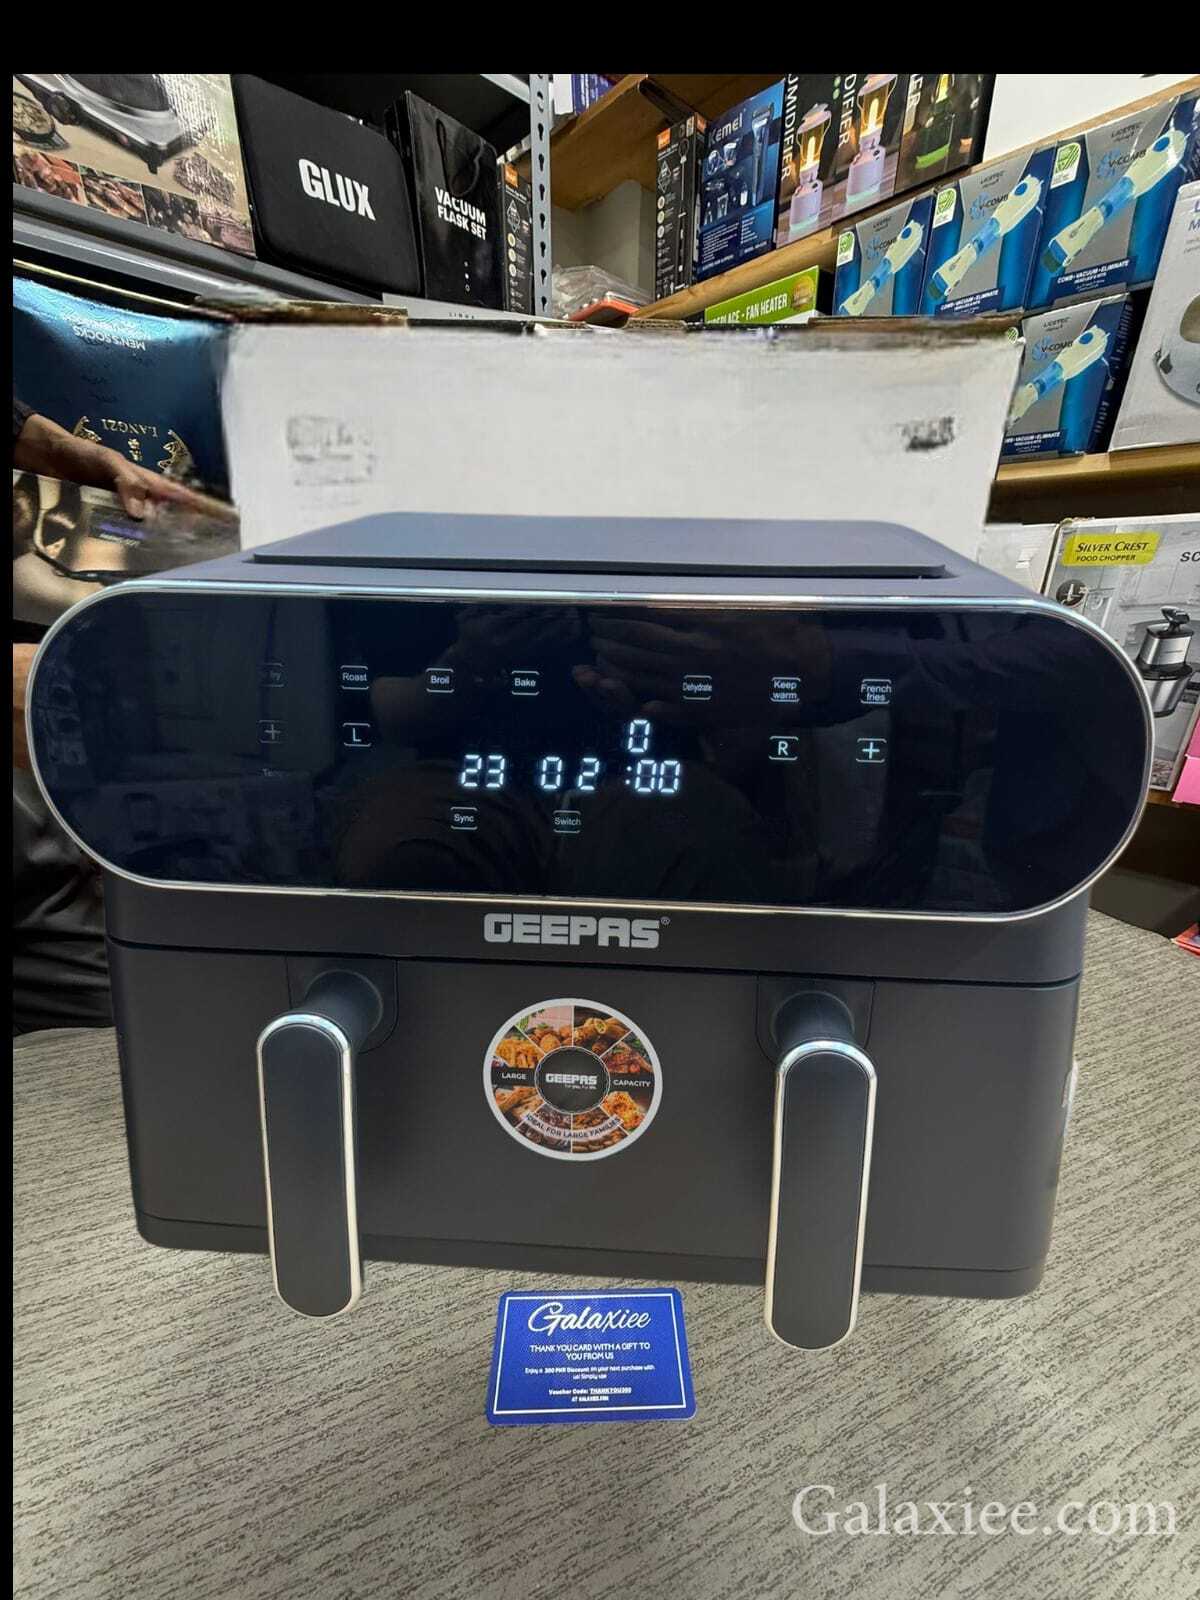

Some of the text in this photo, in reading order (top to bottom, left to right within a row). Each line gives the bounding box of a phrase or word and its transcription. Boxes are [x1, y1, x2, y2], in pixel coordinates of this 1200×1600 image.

[299, 158, 376, 221] GLUX
[435, 186, 486, 227] VACUUM
[438, 205, 486, 240] FLASK SET
[746, 303, 760, 320] FAN
[760, 293, 788, 317] HEATER
[73, 325, 112, 345] SOCKS
[100, 418, 159, 438] LANGZI
[1076, 541, 1149, 553] SILVER CREST
[1100, 554, 1136, 562] CHOPPER
[342, 672, 368, 682] Roast
[430, 675, 450, 685] Broil
[514, 677, 536, 688] Bake
[682, 682, 712, 693] Dehydrate
[773, 680, 797, 690] Keep
[860, 684, 892, 693] French
[772, 691, 797, 700] warm
[866, 692, 886, 702] fries
[352, 727, 362, 742] L
[628, 719, 650, 753] 0
[778, 740, 789, 756] R
[461, 754, 505, 789] 23
[453, 813, 475, 825] Sync
[554, 816, 582, 827] Switch
[502, 1072, 526, 1080] LARGE
[545, 1073, 598, 1085] GEEPAS
[613, 1079, 651, 1088] CAPACITY
[528, 1302, 651, 1336] Galaxiee
[529, 1344, 556, 1352] THANK
[556, 1344, 573, 1352] YOU
[593, 1343, 615, 1351] WITH
[621, 1342, 638, 1351] GIFT
[638, 1342, 651, 1350] TO
[566, 1351, 614, 1361] YOU FROM US
